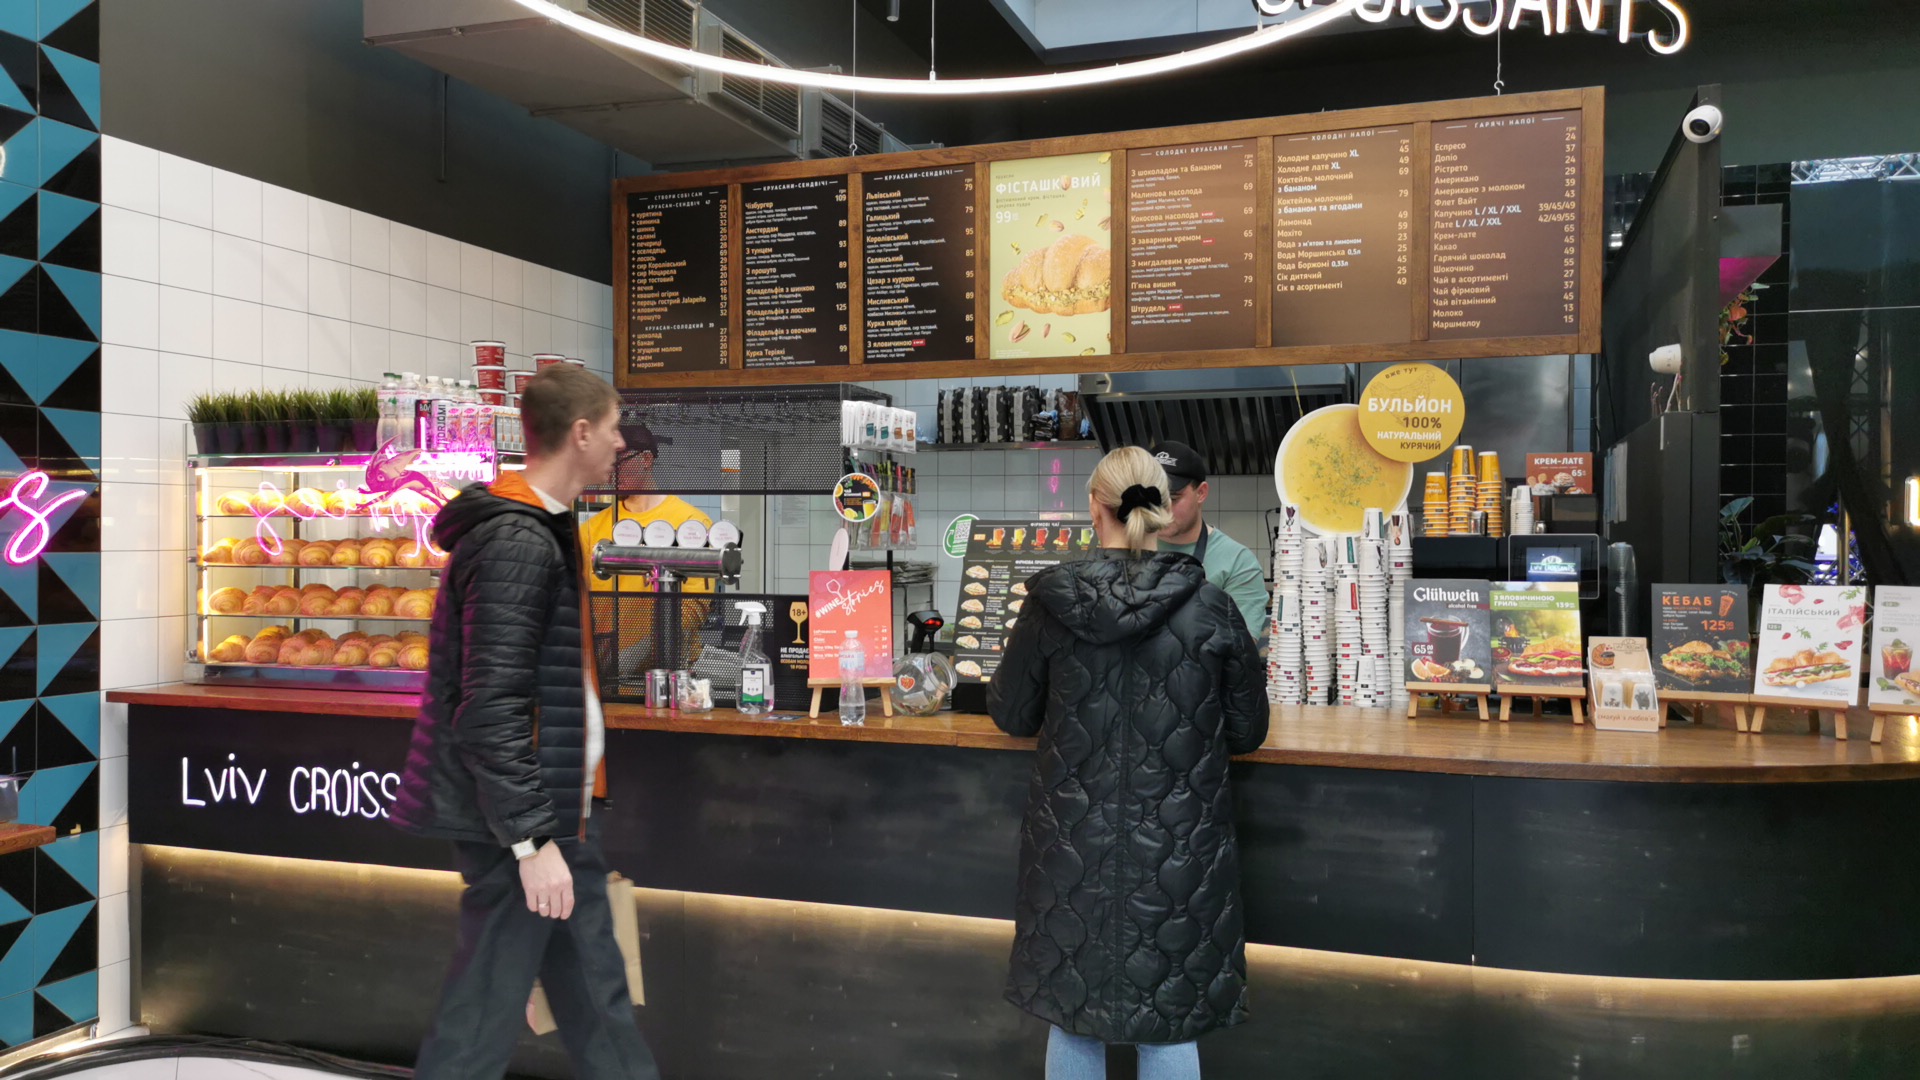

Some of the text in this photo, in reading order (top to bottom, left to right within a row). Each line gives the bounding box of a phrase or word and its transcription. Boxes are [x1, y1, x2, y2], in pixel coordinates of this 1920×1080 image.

[1509, 117, 1535, 126] НАПОЇ
[1435, 133, 1576, 151] Еспресо 24
[1312, 152, 1347, 161] капучино
[1435, 144, 1576, 163] Допіо 37
[1138, 168, 1178, 176] шоколадом
[1435, 165, 1468, 174] Рістрето
[884, 170, 953, 180] КРУАСАНИ-СЕНДВІЧІ
[1278, 176, 1312, 184] Коктейль
[1315, 172, 1353, 181] молочний
[1435, 167, 1575, 185] Американо 29
[1169, 188, 1202, 196] насолода
[1284, 184, 1316, 192] бананом
[1435, 187, 1479, 196] Американо
[866, 191, 901, 200] Львівський
[1458, 197, 1477, 205] Вайт
[1435, 209, 1472, 218] Капучино
[1488, 206, 1498, 214] XL
[1507, 205, 1521, 213] XXL
[1538, 202, 1575, 211] 39/45/49
[996, 211, 1011, 223] 99
[1138, 236, 1172, 244] заварним
[1174, 234, 1201, 242] кремом
[1434, 232, 1476, 241] Крем-лате
[1298, 250, 1345, 258] Моршинська
[1434, 254, 1467, 263] Гарячий
[1470, 252, 1506, 260] шоколад
[1298, 260, 1329, 270] Боржомі
[1434, 265, 1474, 273] Шокочино
[1290, 272, 1322, 281] дитячий
[1434, 276, 1448, 284] Чай
[1459, 274, 1508, 284] асортименті
[1297, 282, 1342, 291] асортименті
[1434, 287, 1448, 295] Чай
[1451, 286, 1490, 296] фірмовий
[867, 297, 909, 305] Мисливський
[746, 308, 784, 316] Філадельфія
[1433, 320, 1480, 329] Маршмелоу
[1385, 370, 1400, 379] вже
[1368, 395, 1452, 413] БУЛЬЙОН
[1403, 417, 1441, 428] 100%
[1377, 431, 1441, 440] НАТУРАЛЬНИЙ
[1400, 441, 1440, 450] КУРЯЧИЙ
[1534, 457, 1584, 465] КРЕМ-ЛАТЕ
[1413, 587, 1479, 602] Glühwein
[1662, 596, 1712, 606] КЕБАБ
[1768, 607, 1840, 616] ІТАЛІЙСЬКИЙ
[1701, 620, 1725, 631] 125
[1414, 645, 1426, 654] 65
[182, 753, 266, 806] Lviv
